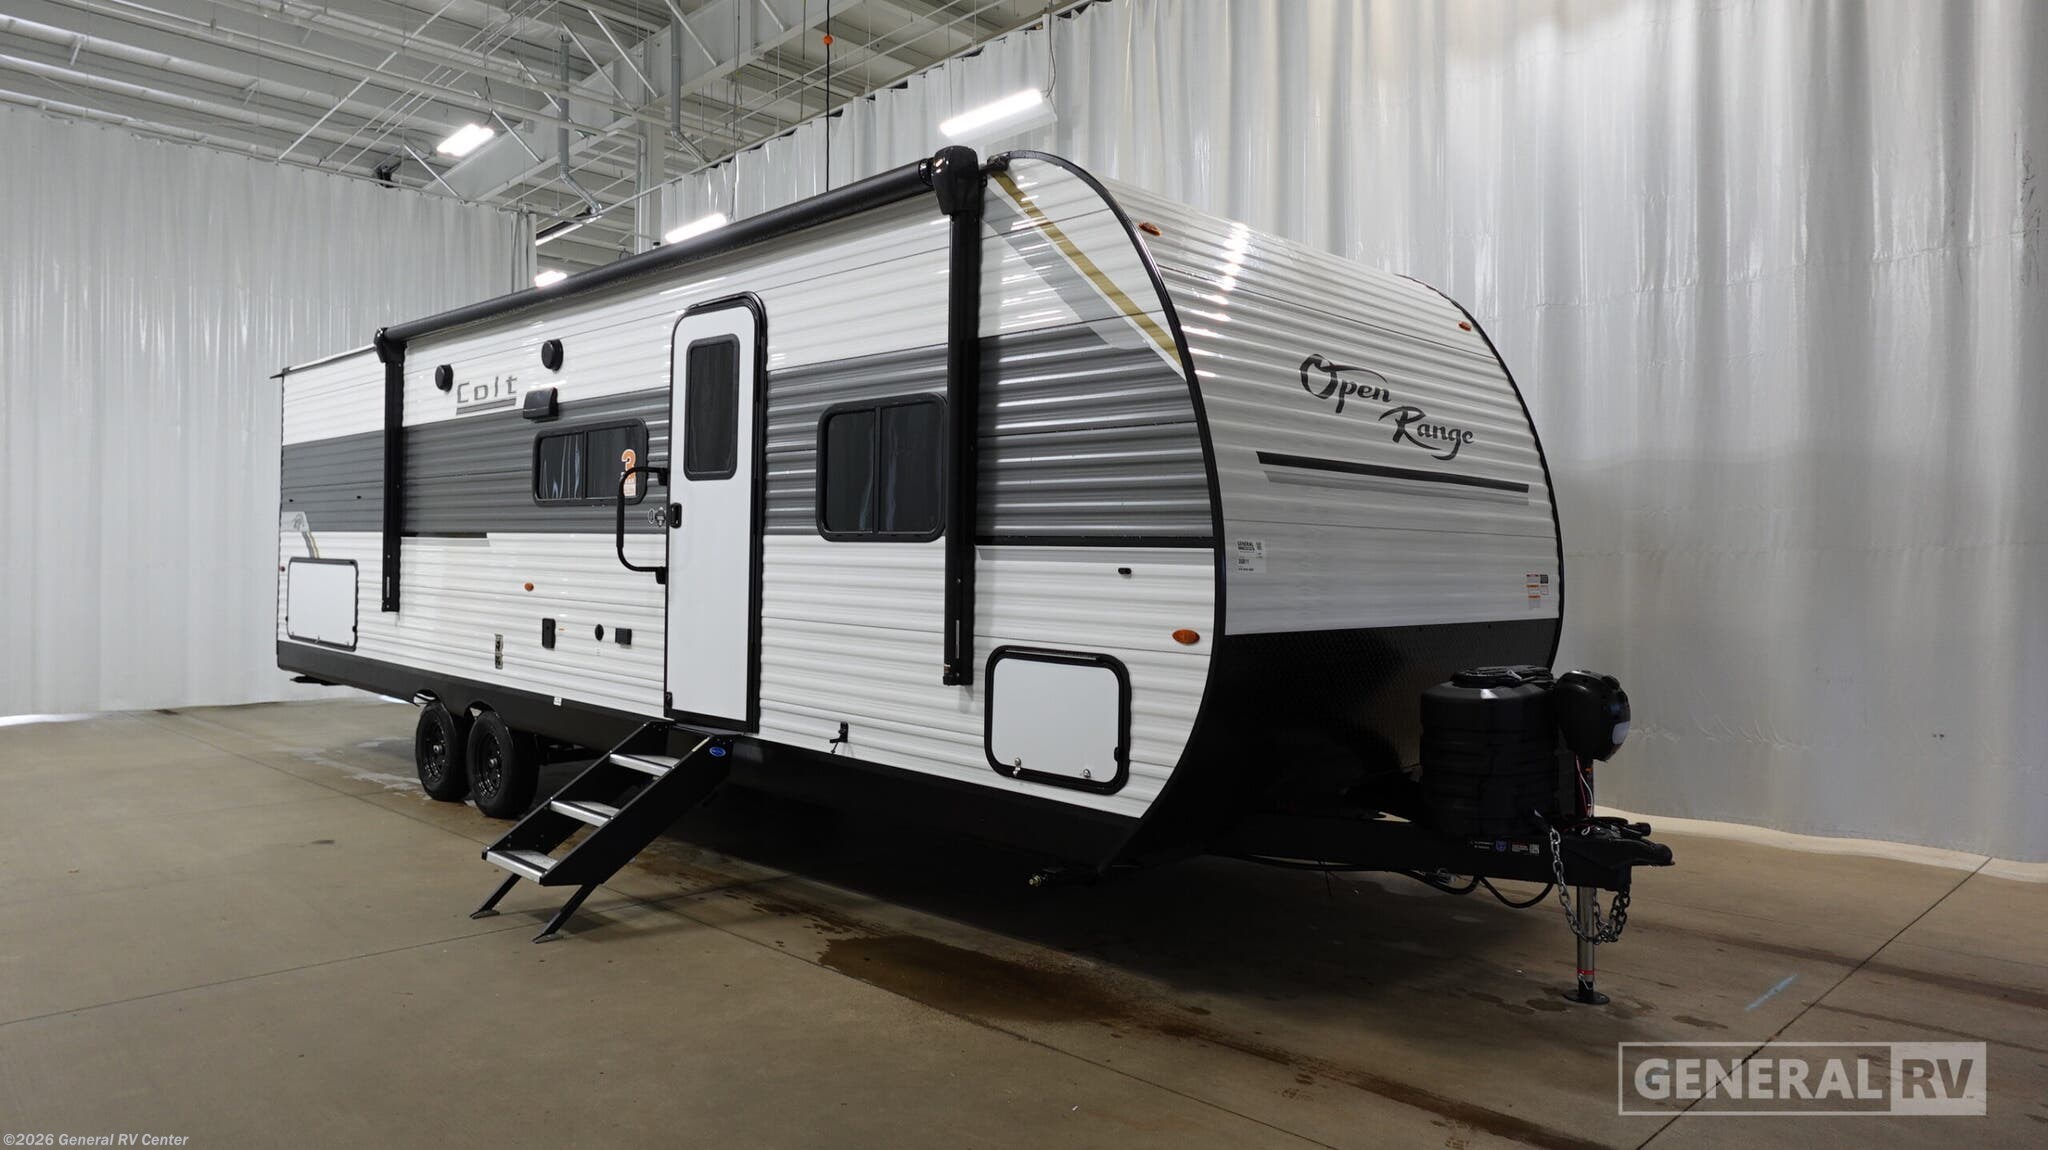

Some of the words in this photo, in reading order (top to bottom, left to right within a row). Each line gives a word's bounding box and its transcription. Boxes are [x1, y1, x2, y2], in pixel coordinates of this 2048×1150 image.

[457, 376, 517, 403] Colt
[1300, 353, 1391, 414] Open
[1378, 405, 1474, 460] Range
